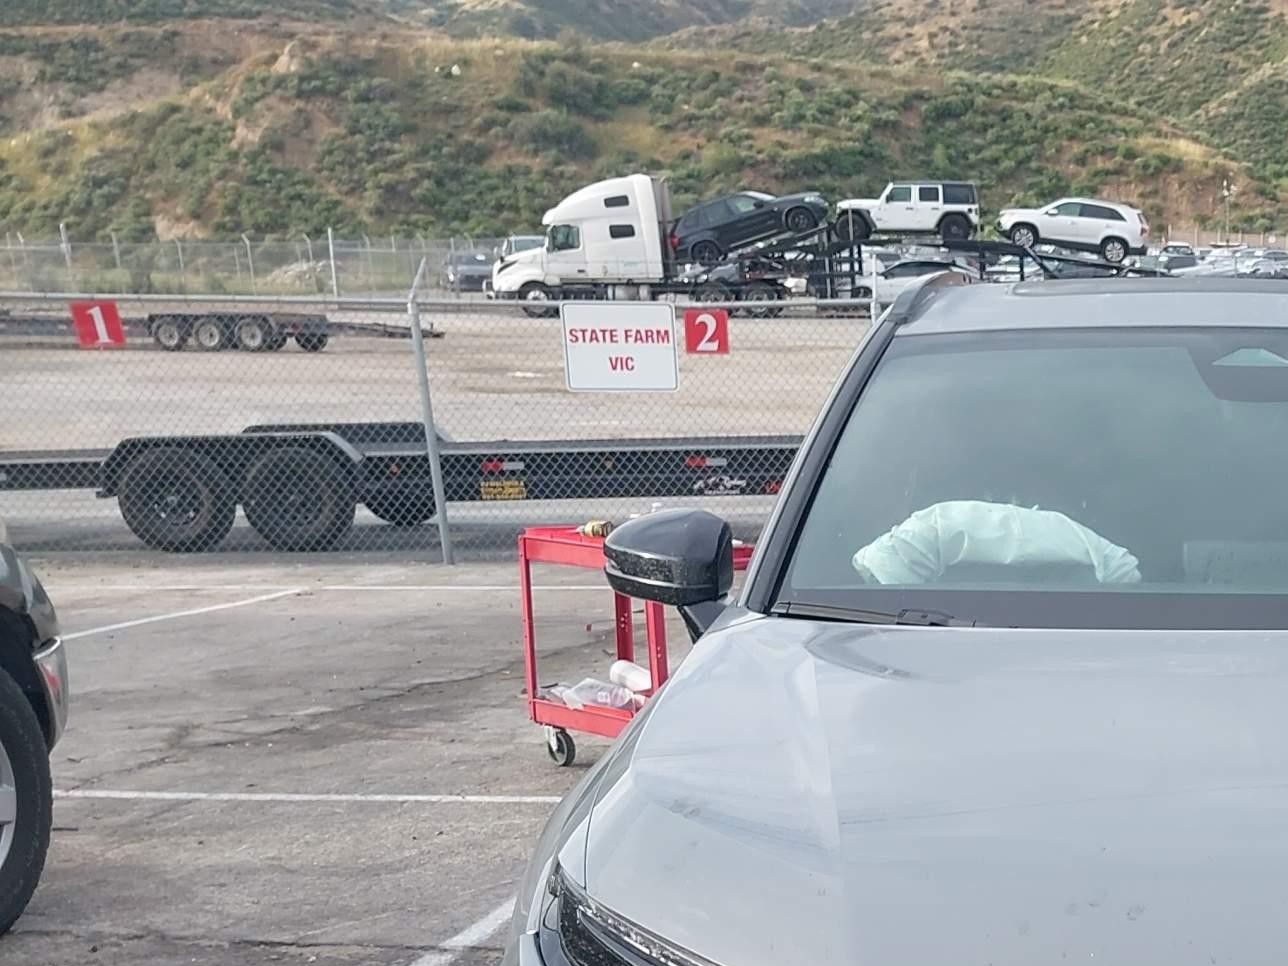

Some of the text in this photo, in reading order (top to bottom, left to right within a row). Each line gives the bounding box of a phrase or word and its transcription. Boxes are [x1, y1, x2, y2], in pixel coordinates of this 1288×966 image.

[86, 306, 115, 344] 1
[568, 328, 671, 345] STATE FARM
[695, 314, 719, 351] 2
[608, 356, 635, 371] VIC
